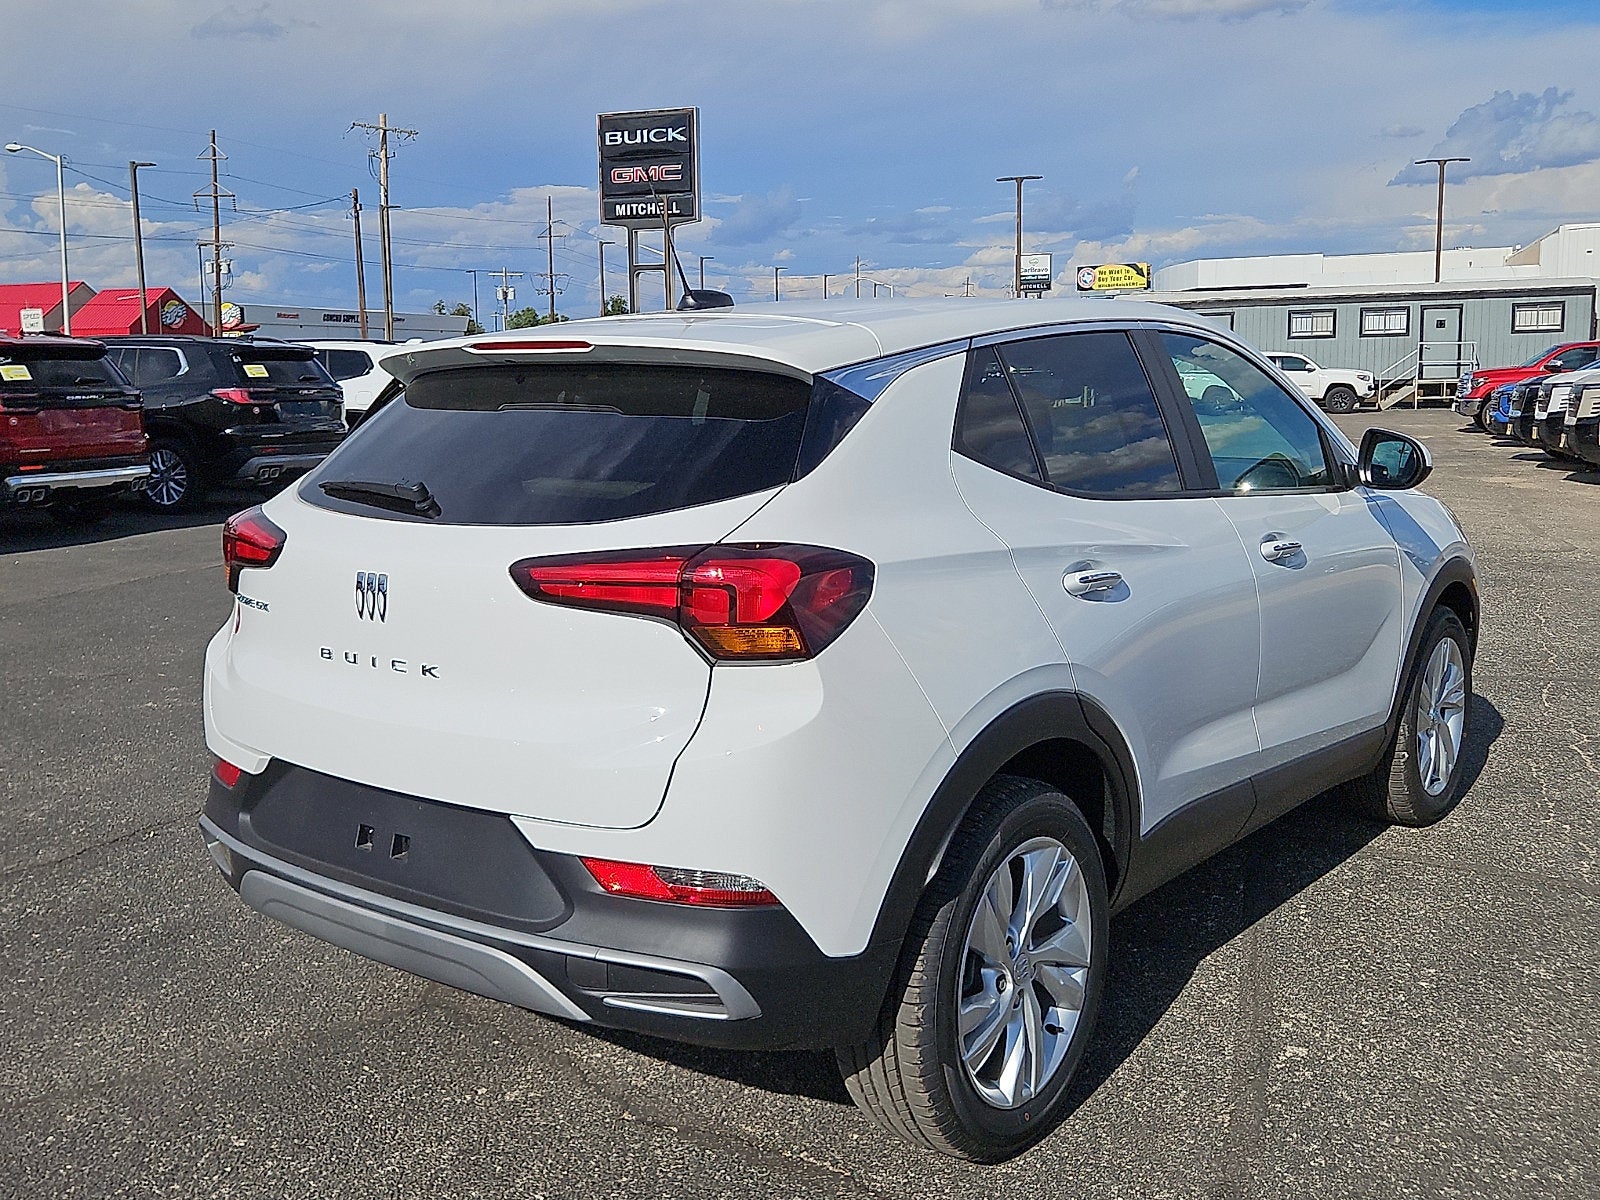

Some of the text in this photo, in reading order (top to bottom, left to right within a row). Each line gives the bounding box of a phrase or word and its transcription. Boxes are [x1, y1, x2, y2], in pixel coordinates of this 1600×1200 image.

[605, 126, 688, 146] BUICK
[611, 164, 682, 184] GMC
[319, 646, 440, 680] BUICK
